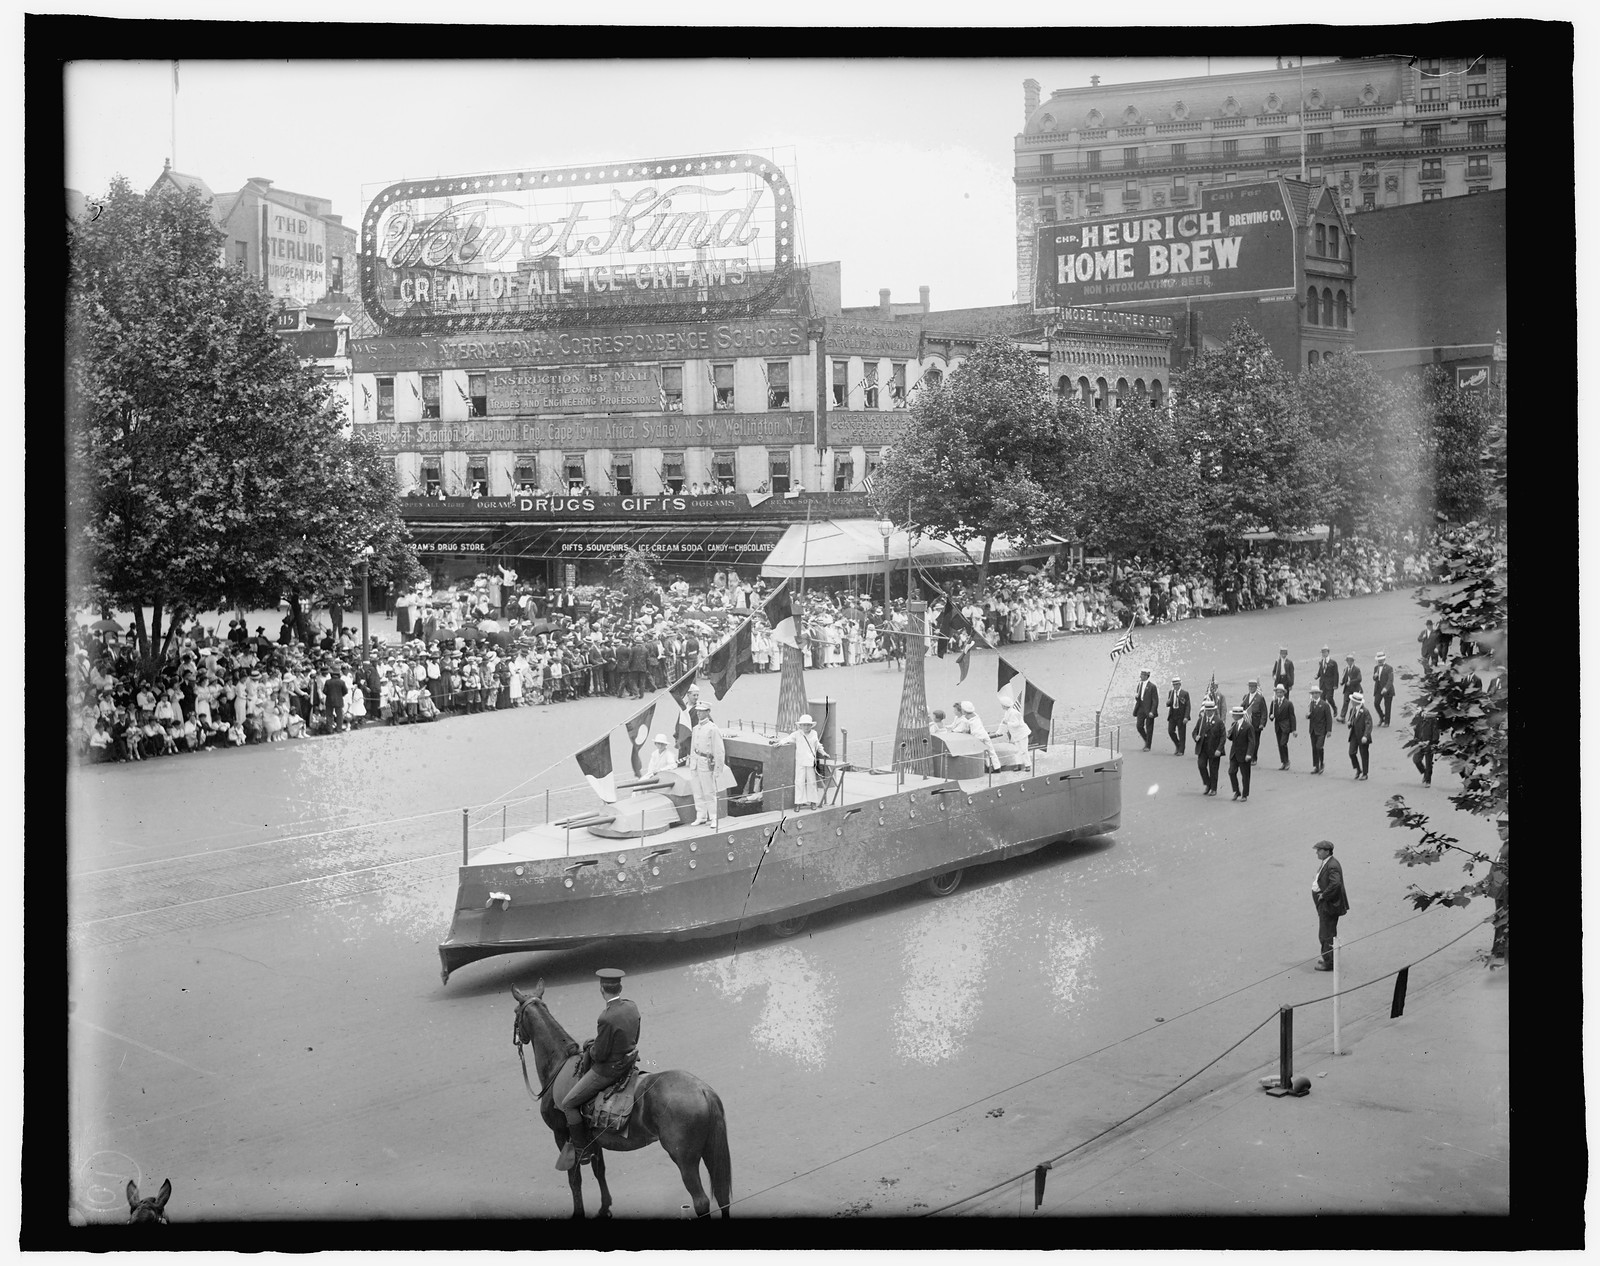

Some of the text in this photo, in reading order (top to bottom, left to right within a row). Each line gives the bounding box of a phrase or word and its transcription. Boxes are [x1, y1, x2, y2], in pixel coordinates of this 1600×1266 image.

[275, 215, 308, 235] THE
[386, 184, 764, 269] Velvet Kind
[1081, 211, 1223, 248] HEURICH
[1228, 210, 1269, 227] BREWING
[1269, 209, 1284, 222] CO.
[268, 237, 324, 264] TERLING
[1057, 236, 1243, 285] HOME BREW
[269, 264, 304, 282] UROPEAN
[400, 257, 748, 303] CREAM OF ALL ICE CREAMS
[1083, 275, 1211, 295] NON INTOXICATING BEER
[1061, 307, 1172, 329] MODEL CLOTHES SHOP
[437, 326, 800, 360] NTERNATIONAL CORRESPONDENCE SCHOOLS
[493, 371, 649, 387] INSTRUCTION BY MAIL
[551, 386, 592, 394] THEORY
[489, 395, 657, 409] TRADES AND ENGINEERING PROFESSIONS
[401, 427, 410, 443] at
[548, 423, 573, 444] Cape
[831, 421, 912, 430] CORRESPONDENC
[520, 498, 595, 511] DRUGS
[621, 498, 686, 511] GIFTS
[405, 543, 485, 551] RAM'S DRUG STORE
[561, 544, 583, 552] GIFTS
[586, 544, 629, 552] SOUVENIRS
[638, 544, 650, 552] ICE
[651, 544, 680, 552] CREAM
[681, 544, 703, 552] SODA
[707, 543, 729, 552] CANDY
[734, 544, 776, 552] CHOCOLATES
